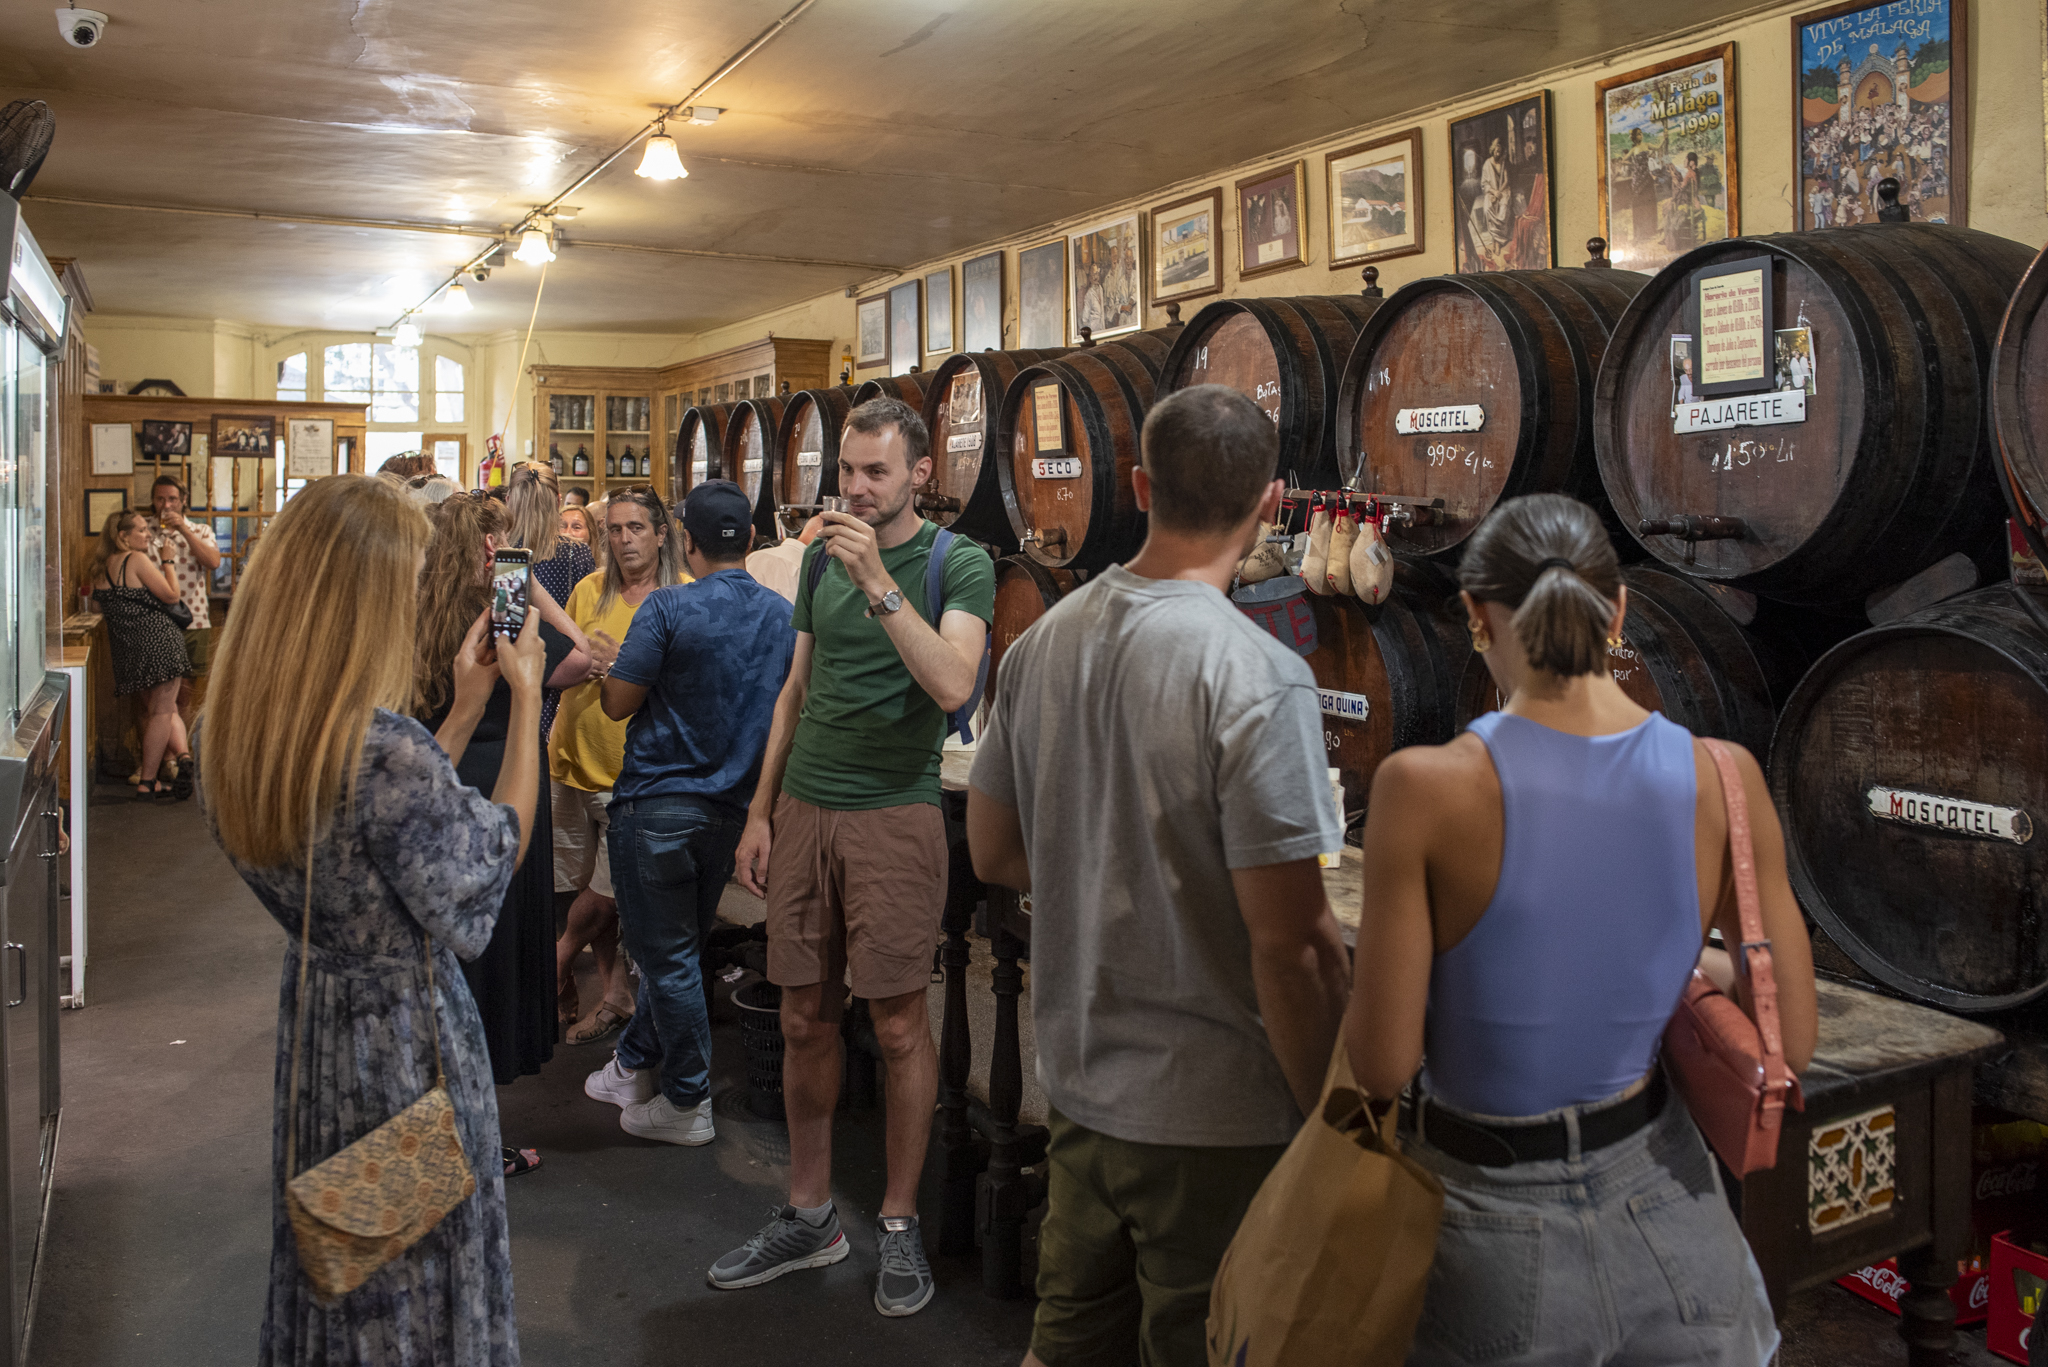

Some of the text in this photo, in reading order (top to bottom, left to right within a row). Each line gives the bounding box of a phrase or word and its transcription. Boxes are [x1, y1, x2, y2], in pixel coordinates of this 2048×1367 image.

[1807, 0, 1943, 44] VIVE LA FERIA
[1817, 19, 1931, 64] DE MÁLAGA
[1670, 72, 1717, 94] Feria de
[1650, 90, 1719, 122] Málaga
[1679, 111, 1720, 137] 1999
[1195, 346, 1208, 370] 19
[1410, 410, 1469, 431] MOSCATEL
[1689, 398, 1783, 427] PAJARETE
[1038, 462, 1072, 476] SECO
[1237, 596, 1313, 648] TE
[1336, 697, 1363, 716] QUINA
[1889, 791, 2000, 834] MOSCATEL
